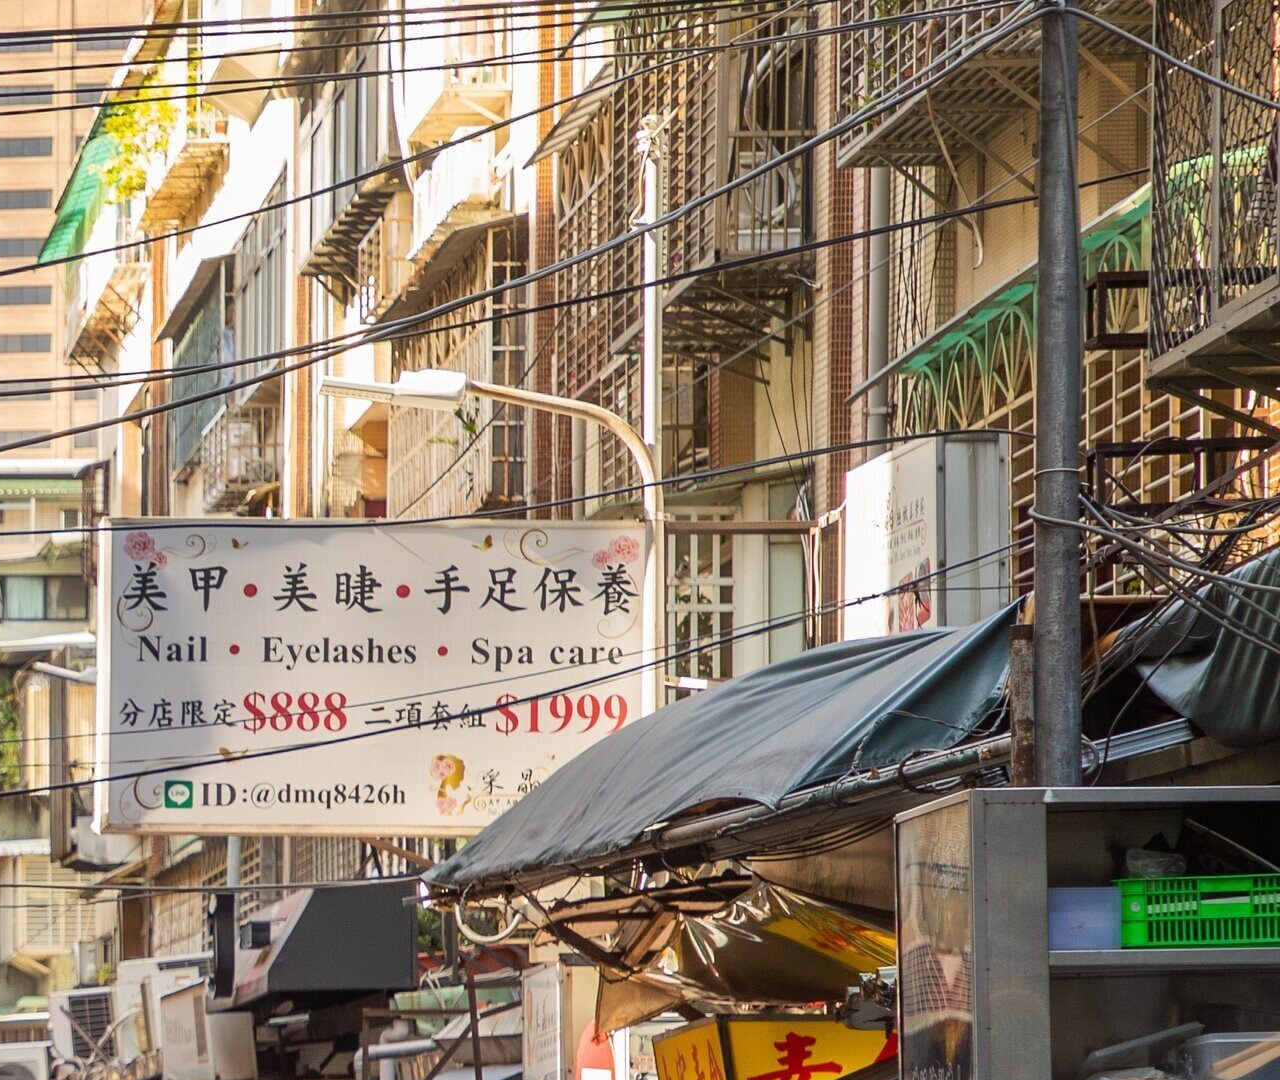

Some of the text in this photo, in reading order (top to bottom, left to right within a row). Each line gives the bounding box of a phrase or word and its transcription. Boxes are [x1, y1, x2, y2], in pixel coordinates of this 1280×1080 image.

[137, 634, 624, 672] Nail Eyelashes Spa care
[119, 697, 238, 729] 分店限定
[242, 690, 349, 737] $888
[494, 691, 629, 737] $1999
